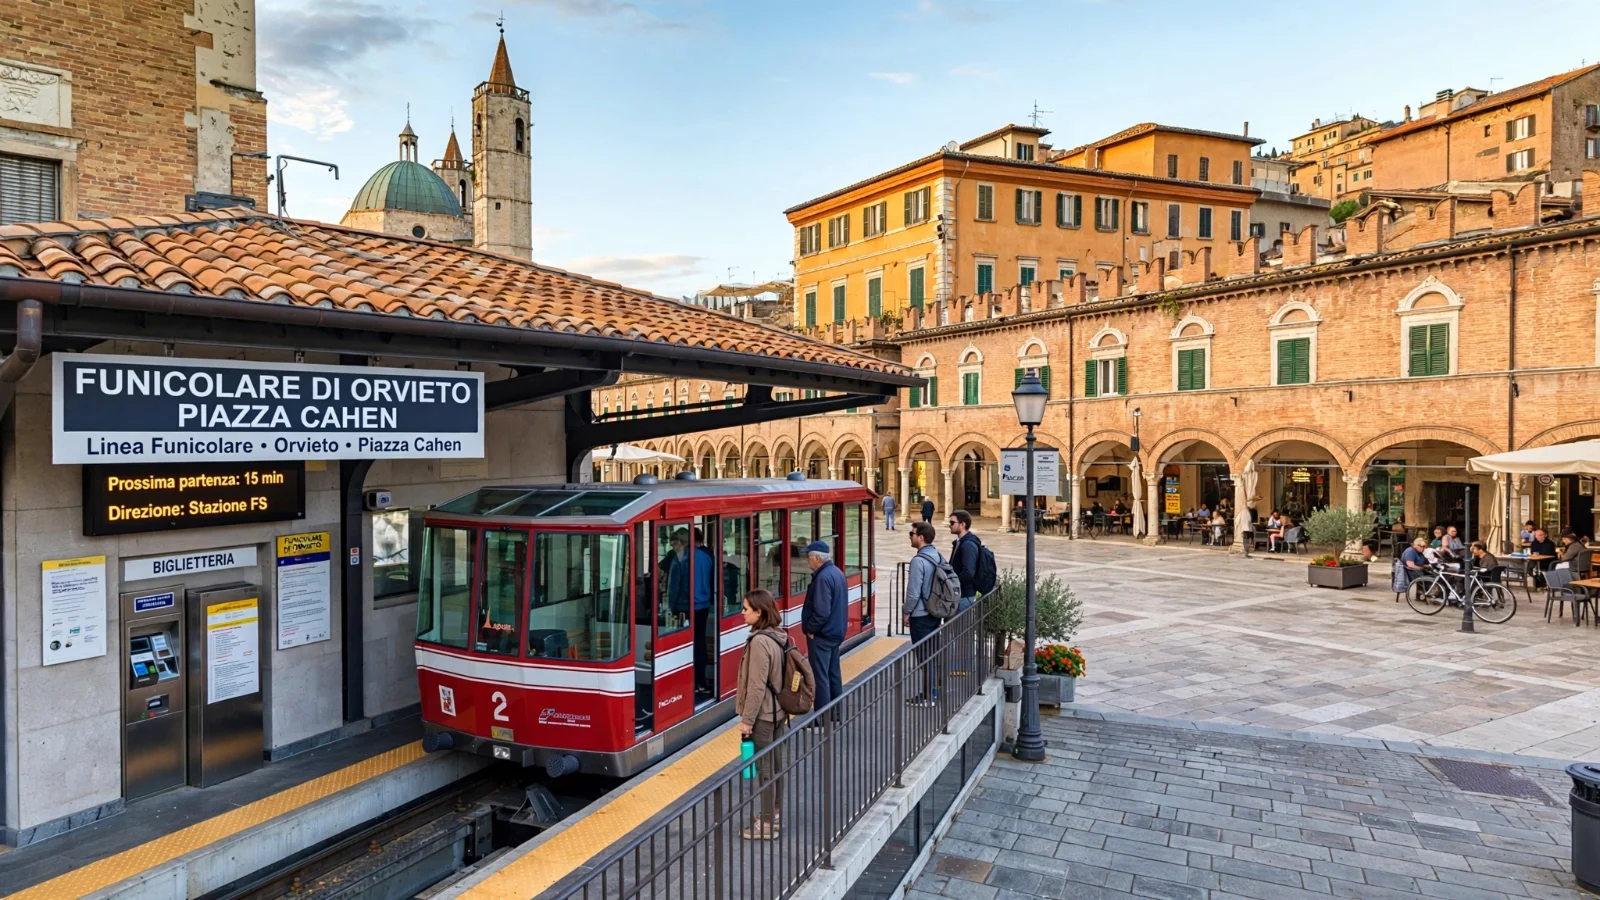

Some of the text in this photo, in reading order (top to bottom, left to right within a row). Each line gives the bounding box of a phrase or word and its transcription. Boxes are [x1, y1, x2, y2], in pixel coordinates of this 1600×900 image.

[76, 367, 471, 404] FUNICOLARE DI ORVIETO
[178, 403, 398, 429] PIAZZA CAHEN
[87, 437, 462, 455] Linea Funicolare Orvieto Piazza Cahen
[108, 471, 284, 491] Prossima partenza: 15 min
[108, 496, 268, 521] Direzione: Stazione FS
[153, 552, 235, 574] BIGLIETTERIA
[491, 690, 510, 722] 2
